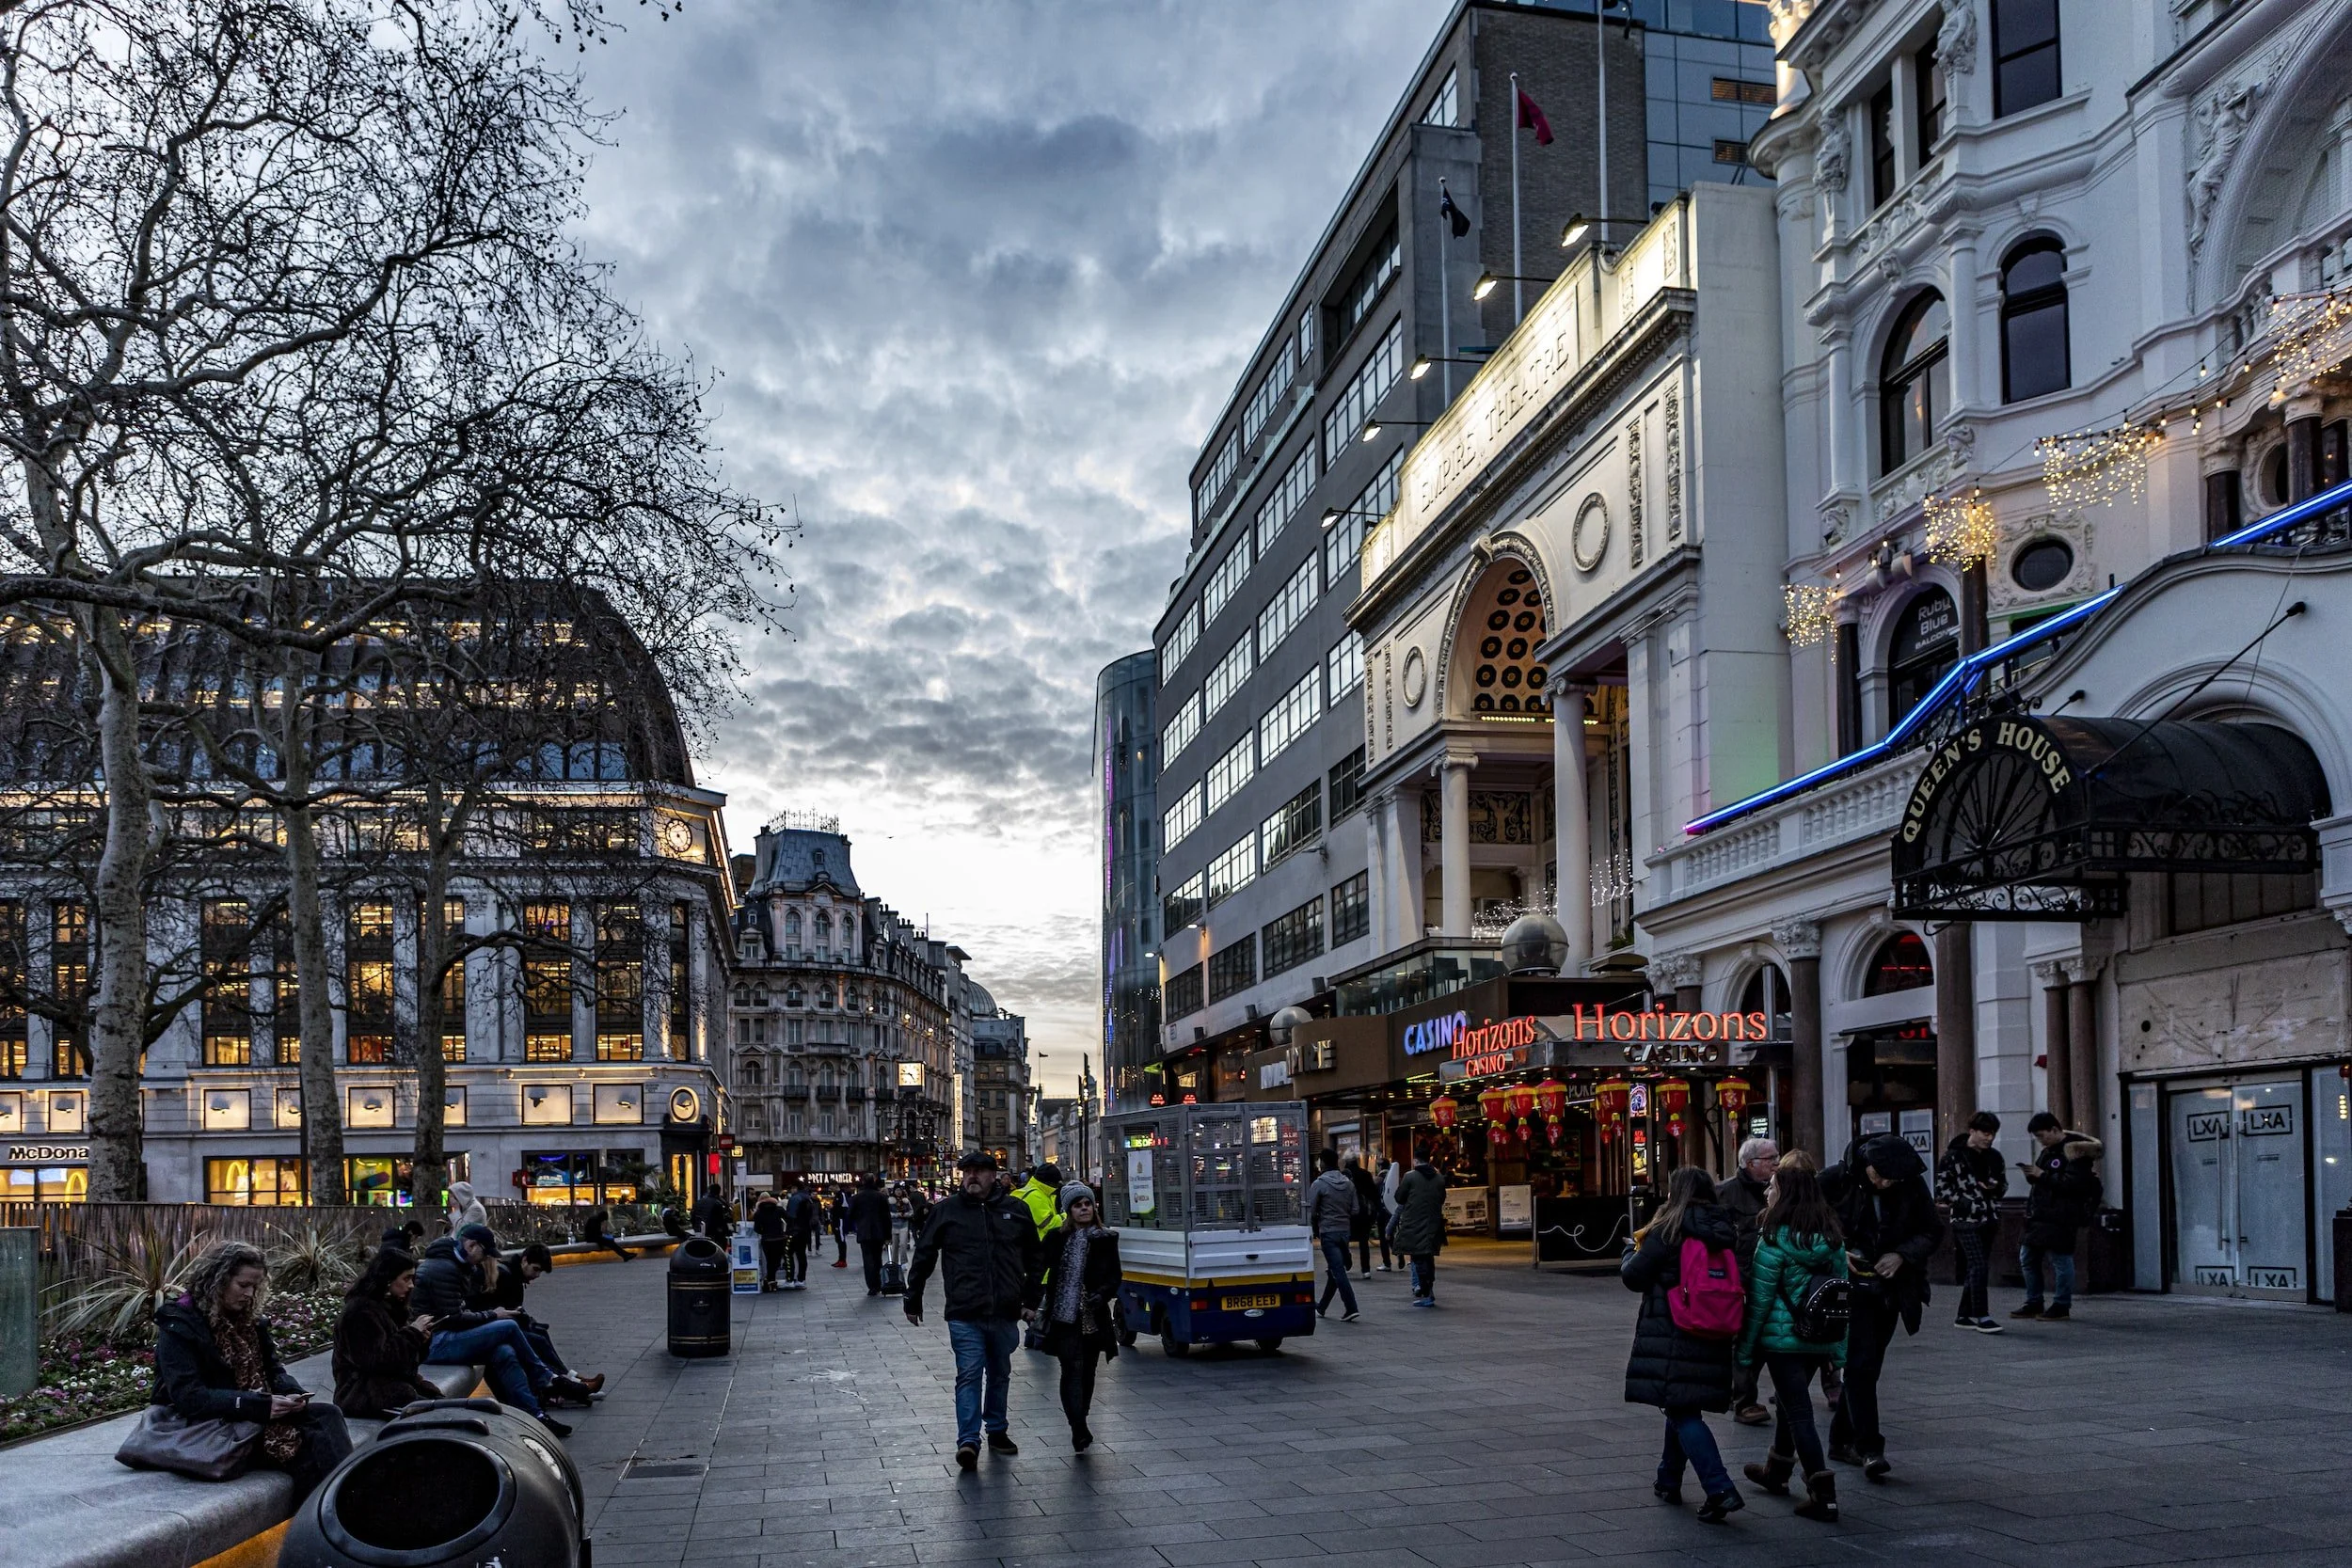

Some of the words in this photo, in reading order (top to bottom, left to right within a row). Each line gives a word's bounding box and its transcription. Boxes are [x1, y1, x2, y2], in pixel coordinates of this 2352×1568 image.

[1422, 431, 1477, 513] EMPIRE
[1485, 330, 1569, 442] THEATRE
[1918, 596, 1952, 621] Ruby
[1920, 613, 1948, 636] Blue
[1915, 629, 1949, 650] BALCON
[1902, 728, 1982, 843] QUEEN'S
[1996, 721, 2072, 794] HOUSE
[1404, 1010, 1468, 1055] CASINO
[1572, 1002, 1767, 1041] Horizons
[1452, 1016, 1536, 1060] Horizons
[1623, 1043, 1719, 1064] CASINO
[1466, 1053, 1506, 1078] CASINO
[1568, 1085, 1597, 1099] POKE
[2193, 1117, 2221, 1136] LXA
[2250, 1112, 2286, 1131] LXA
[8, 1146, 89, 1160] McDona
[807, 1173, 823, 1184] PRET
[830, 1173, 853, 1183] MANGER
[1226, 1296, 1253, 1308] BR68
[1256, 1295, 1277, 1307] EEB
